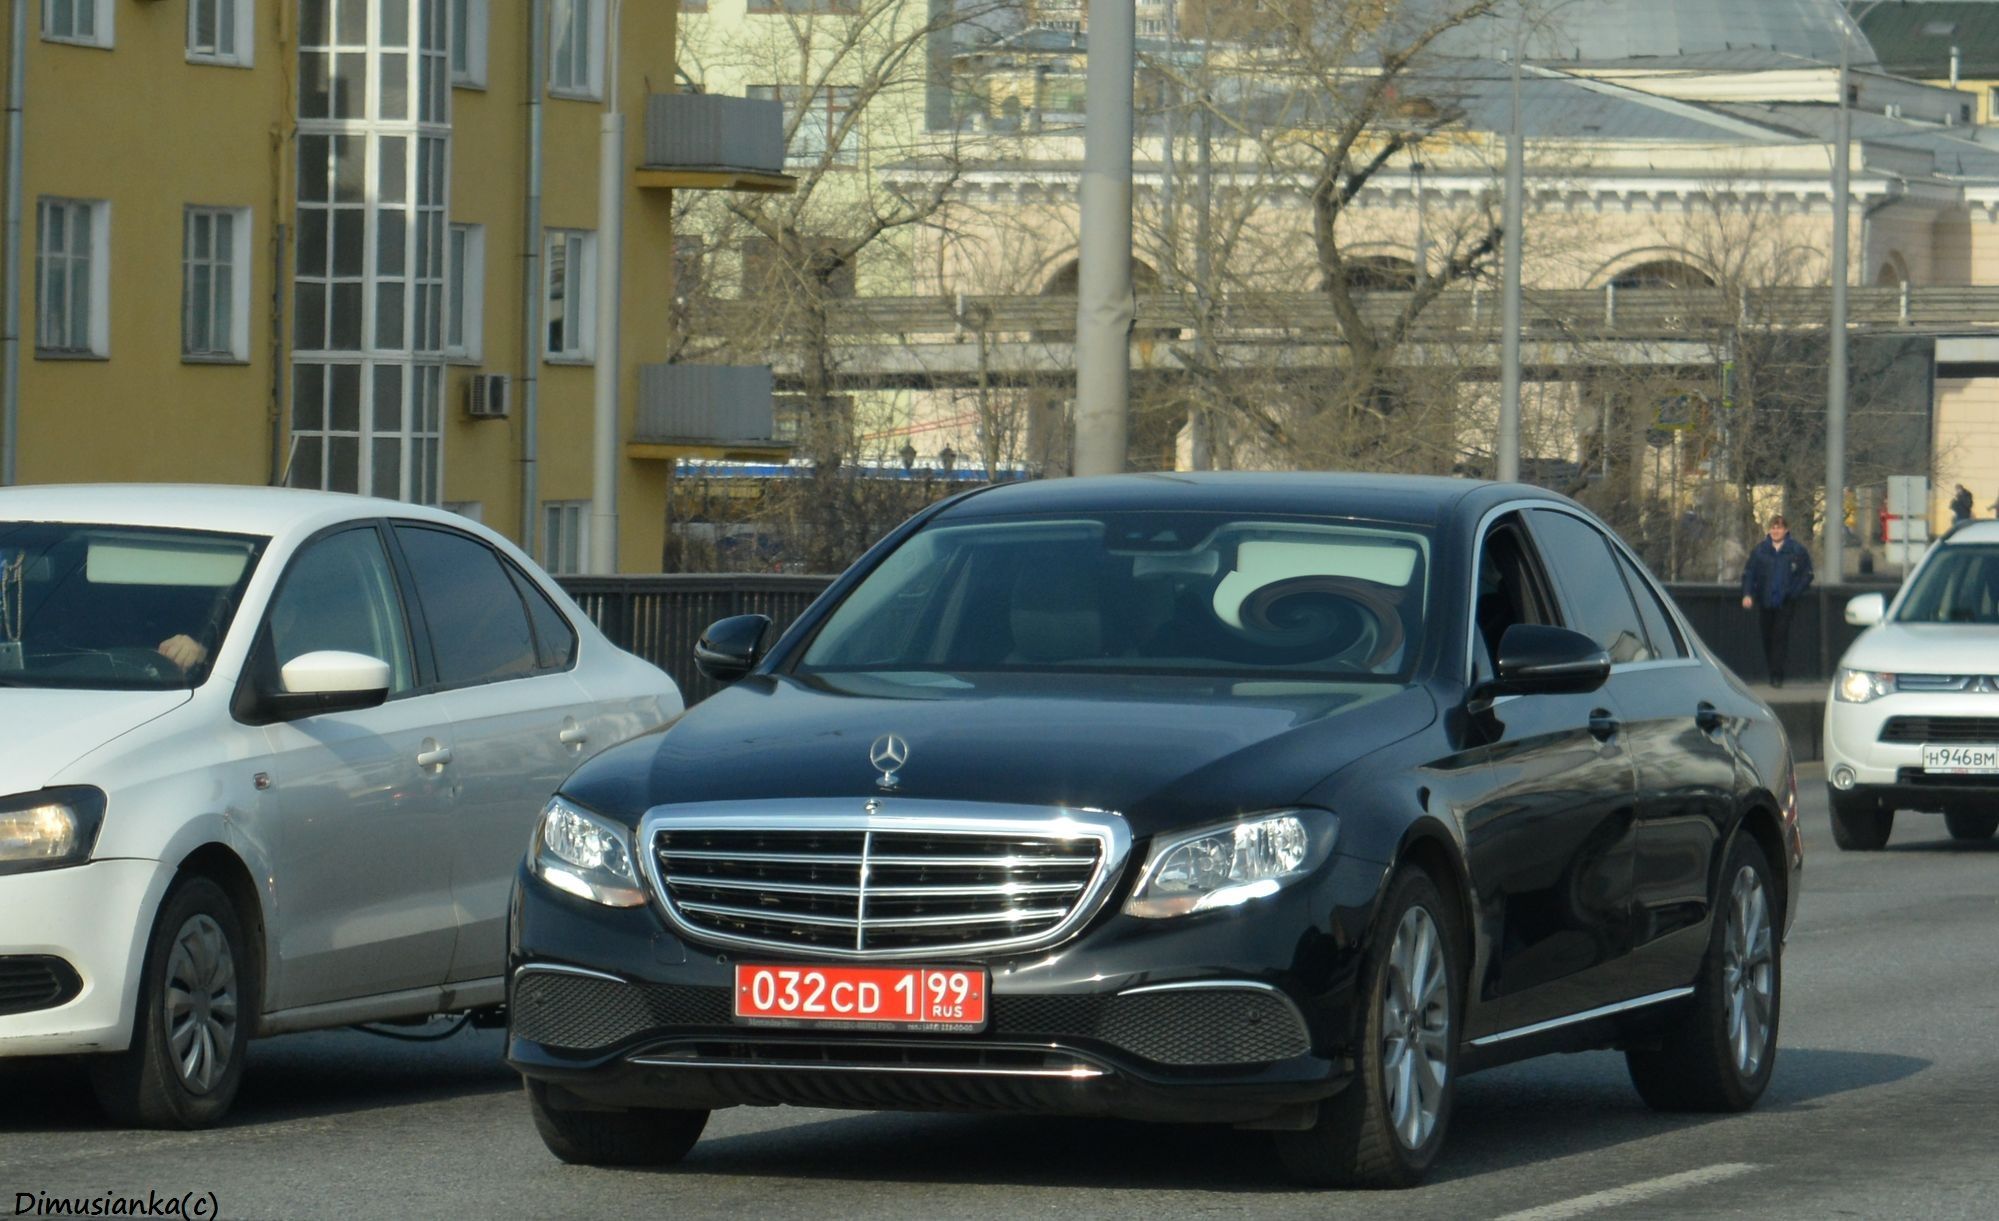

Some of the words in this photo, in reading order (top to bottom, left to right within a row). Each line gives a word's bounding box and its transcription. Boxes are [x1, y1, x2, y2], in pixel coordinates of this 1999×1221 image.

[752, 970, 880, 1013] 032CD
[894, 974, 914, 1014] 1
[927, 973, 969, 1003] 99
[932, 1006, 963, 1017] RUS
